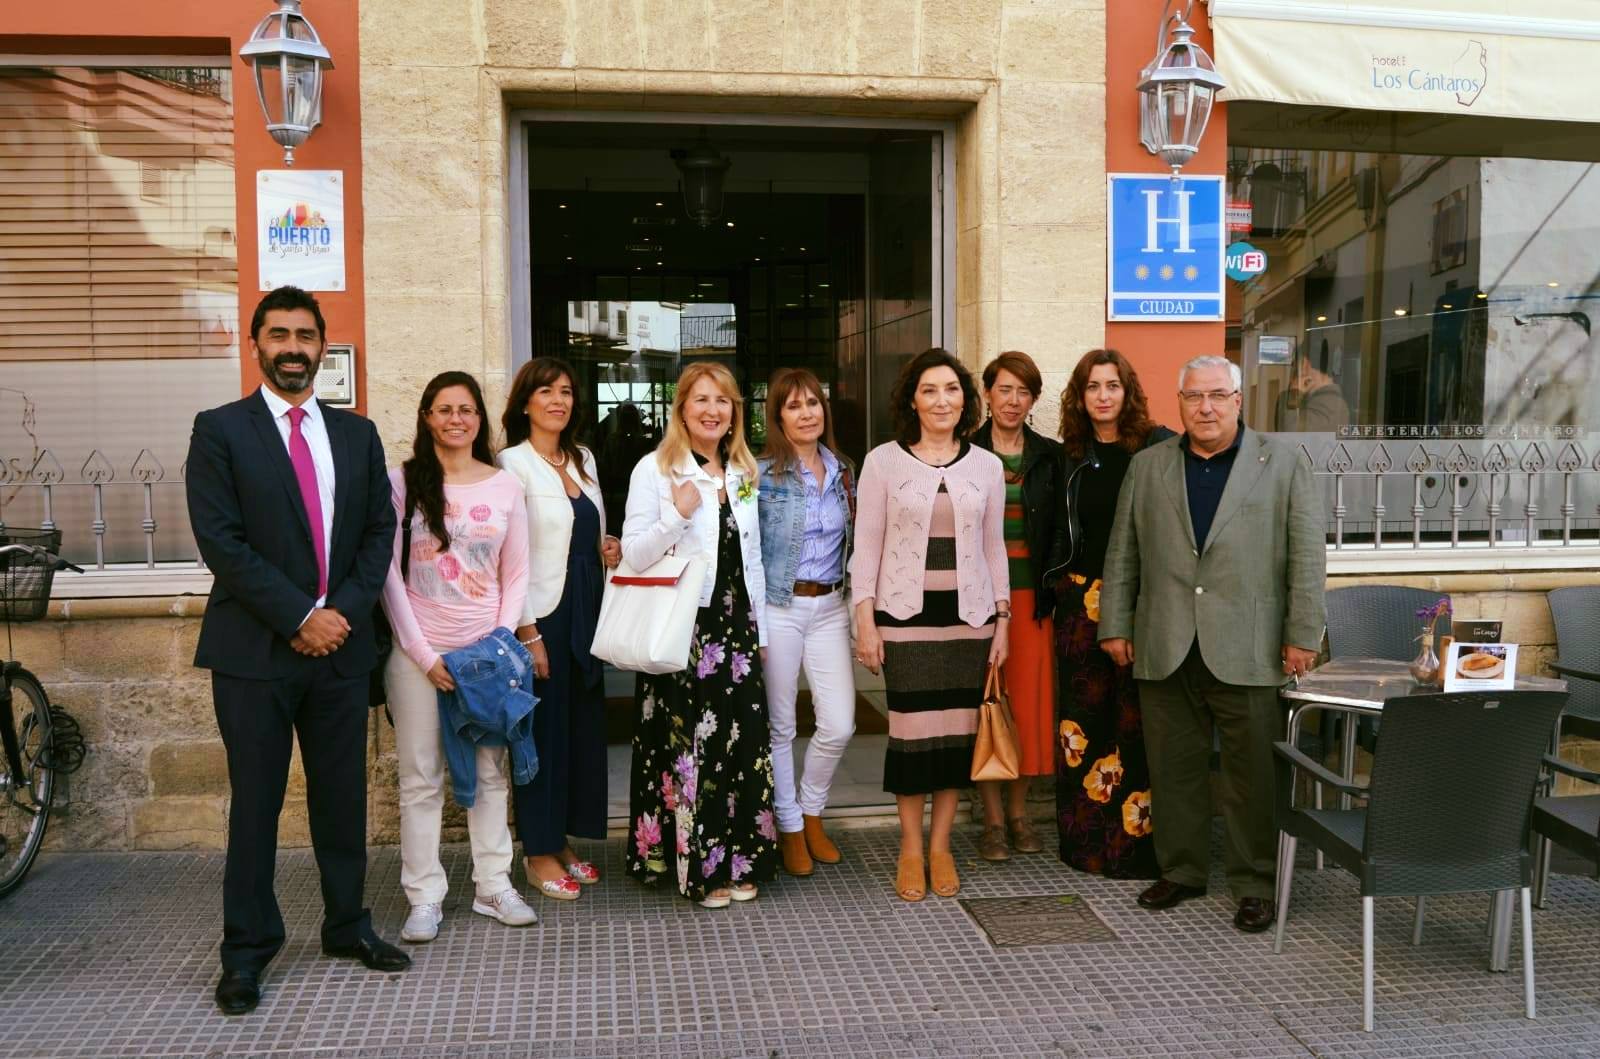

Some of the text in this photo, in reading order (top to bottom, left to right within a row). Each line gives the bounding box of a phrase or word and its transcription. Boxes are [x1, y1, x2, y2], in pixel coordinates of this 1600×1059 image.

[1372, 67, 1480, 92] Los Cántaros
[1141, 190, 1196, 253] H
[268, 226, 330, 245] PUERTO
[1139, 300, 1194, 314] CIUDAD
[1454, 426, 1484, 436] LOS
